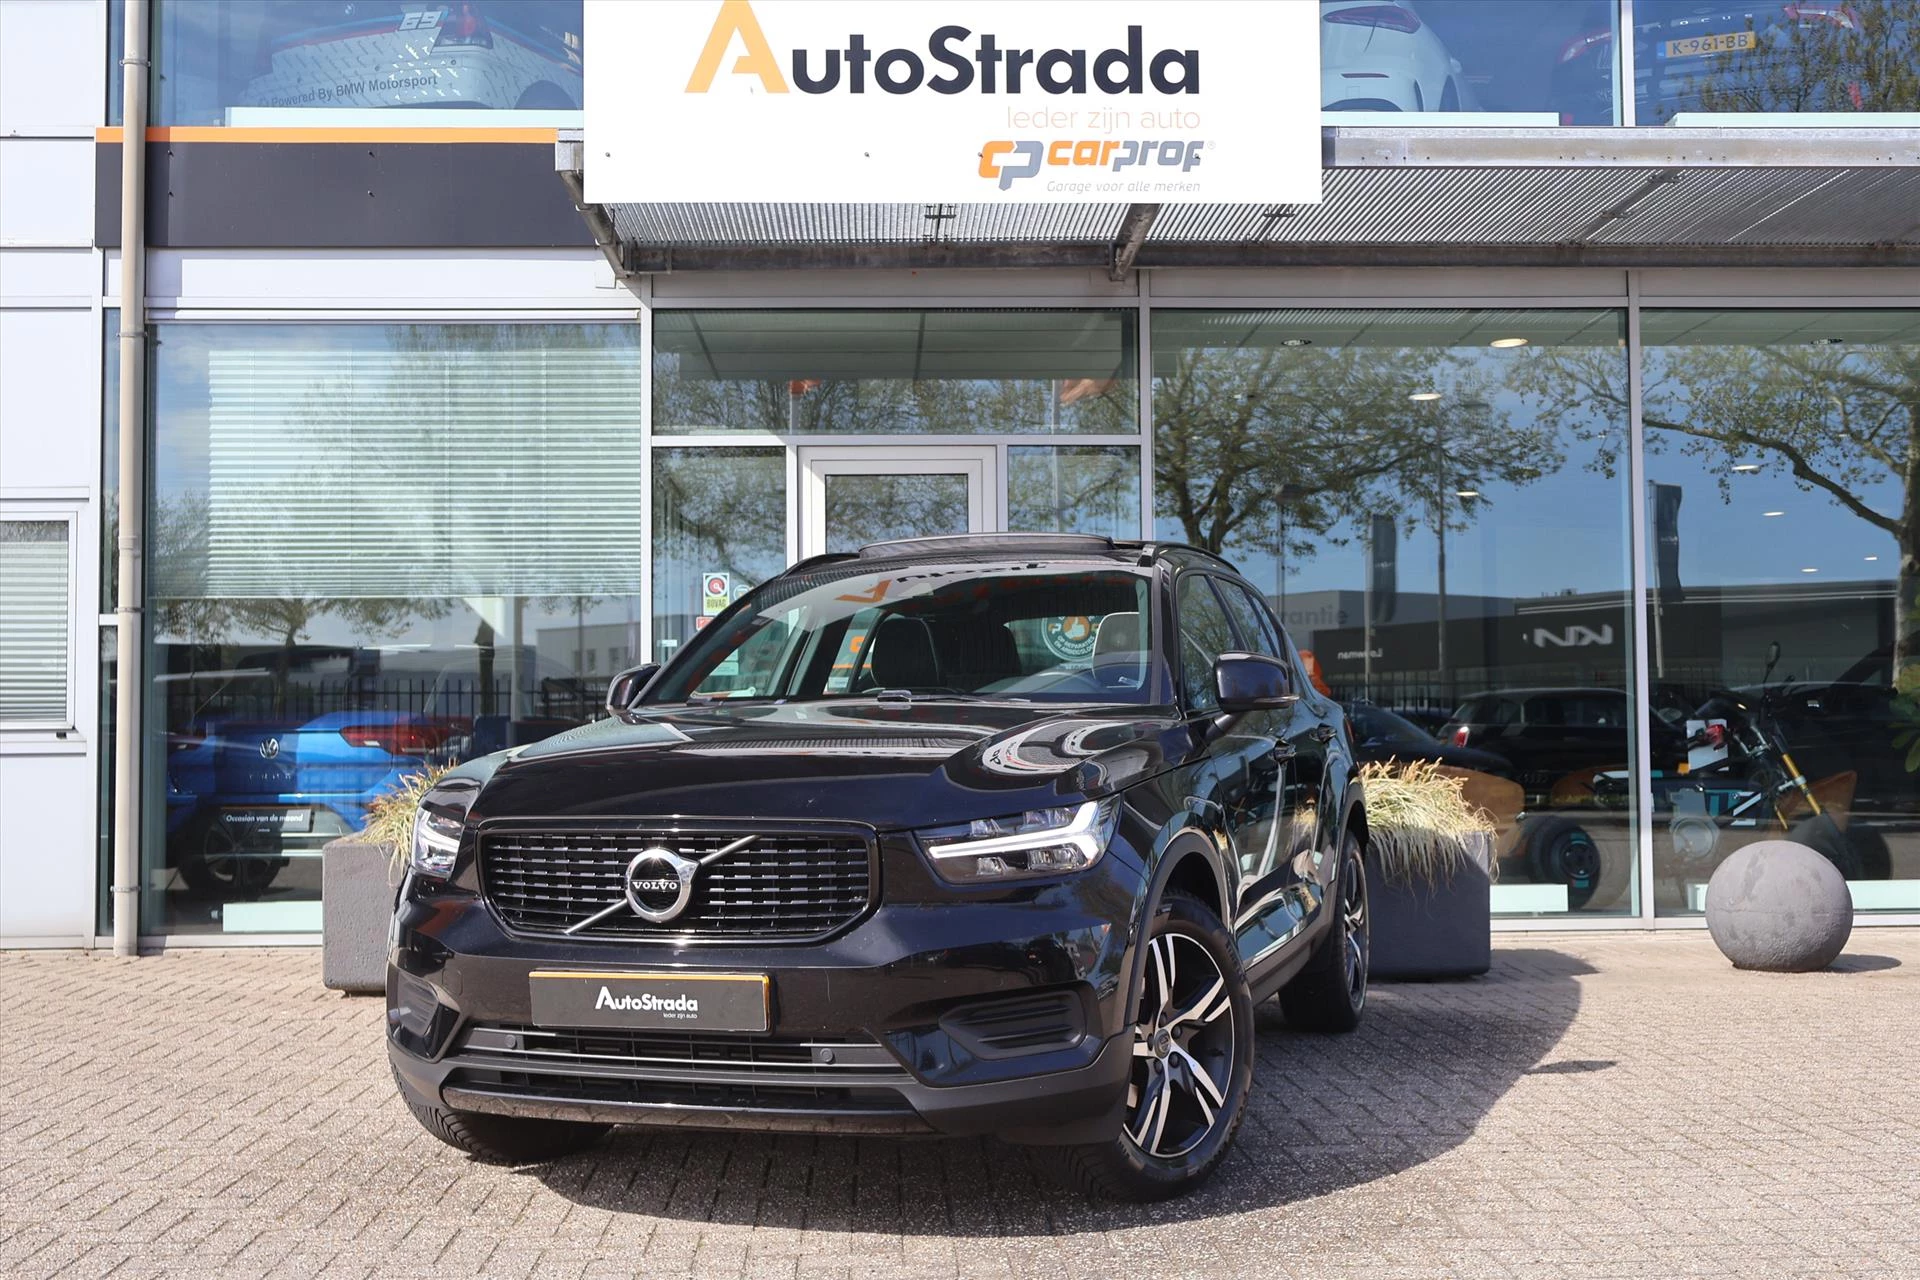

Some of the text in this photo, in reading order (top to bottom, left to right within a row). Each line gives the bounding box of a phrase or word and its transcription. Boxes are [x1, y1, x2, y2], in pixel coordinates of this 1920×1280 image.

[400, 11, 442, 31] 69
[684, 0, 1200, 94] AutoStrada
[1672, 35, 1748, 55] K-961-BB
[271, 75, 438, 107] Powered By BMW Motorsport
[1007, 106, 1200, 135] Ieder zijn auto
[1047, 180, 1200, 193] Garage voor alle merken
[226, 813, 255, 823] Occasion
[269, 813, 279, 822] de
[279, 812, 304, 822] maand
[632, 881, 678, 890] VOLVO
[595, 986, 698, 1011] AutoStrada
